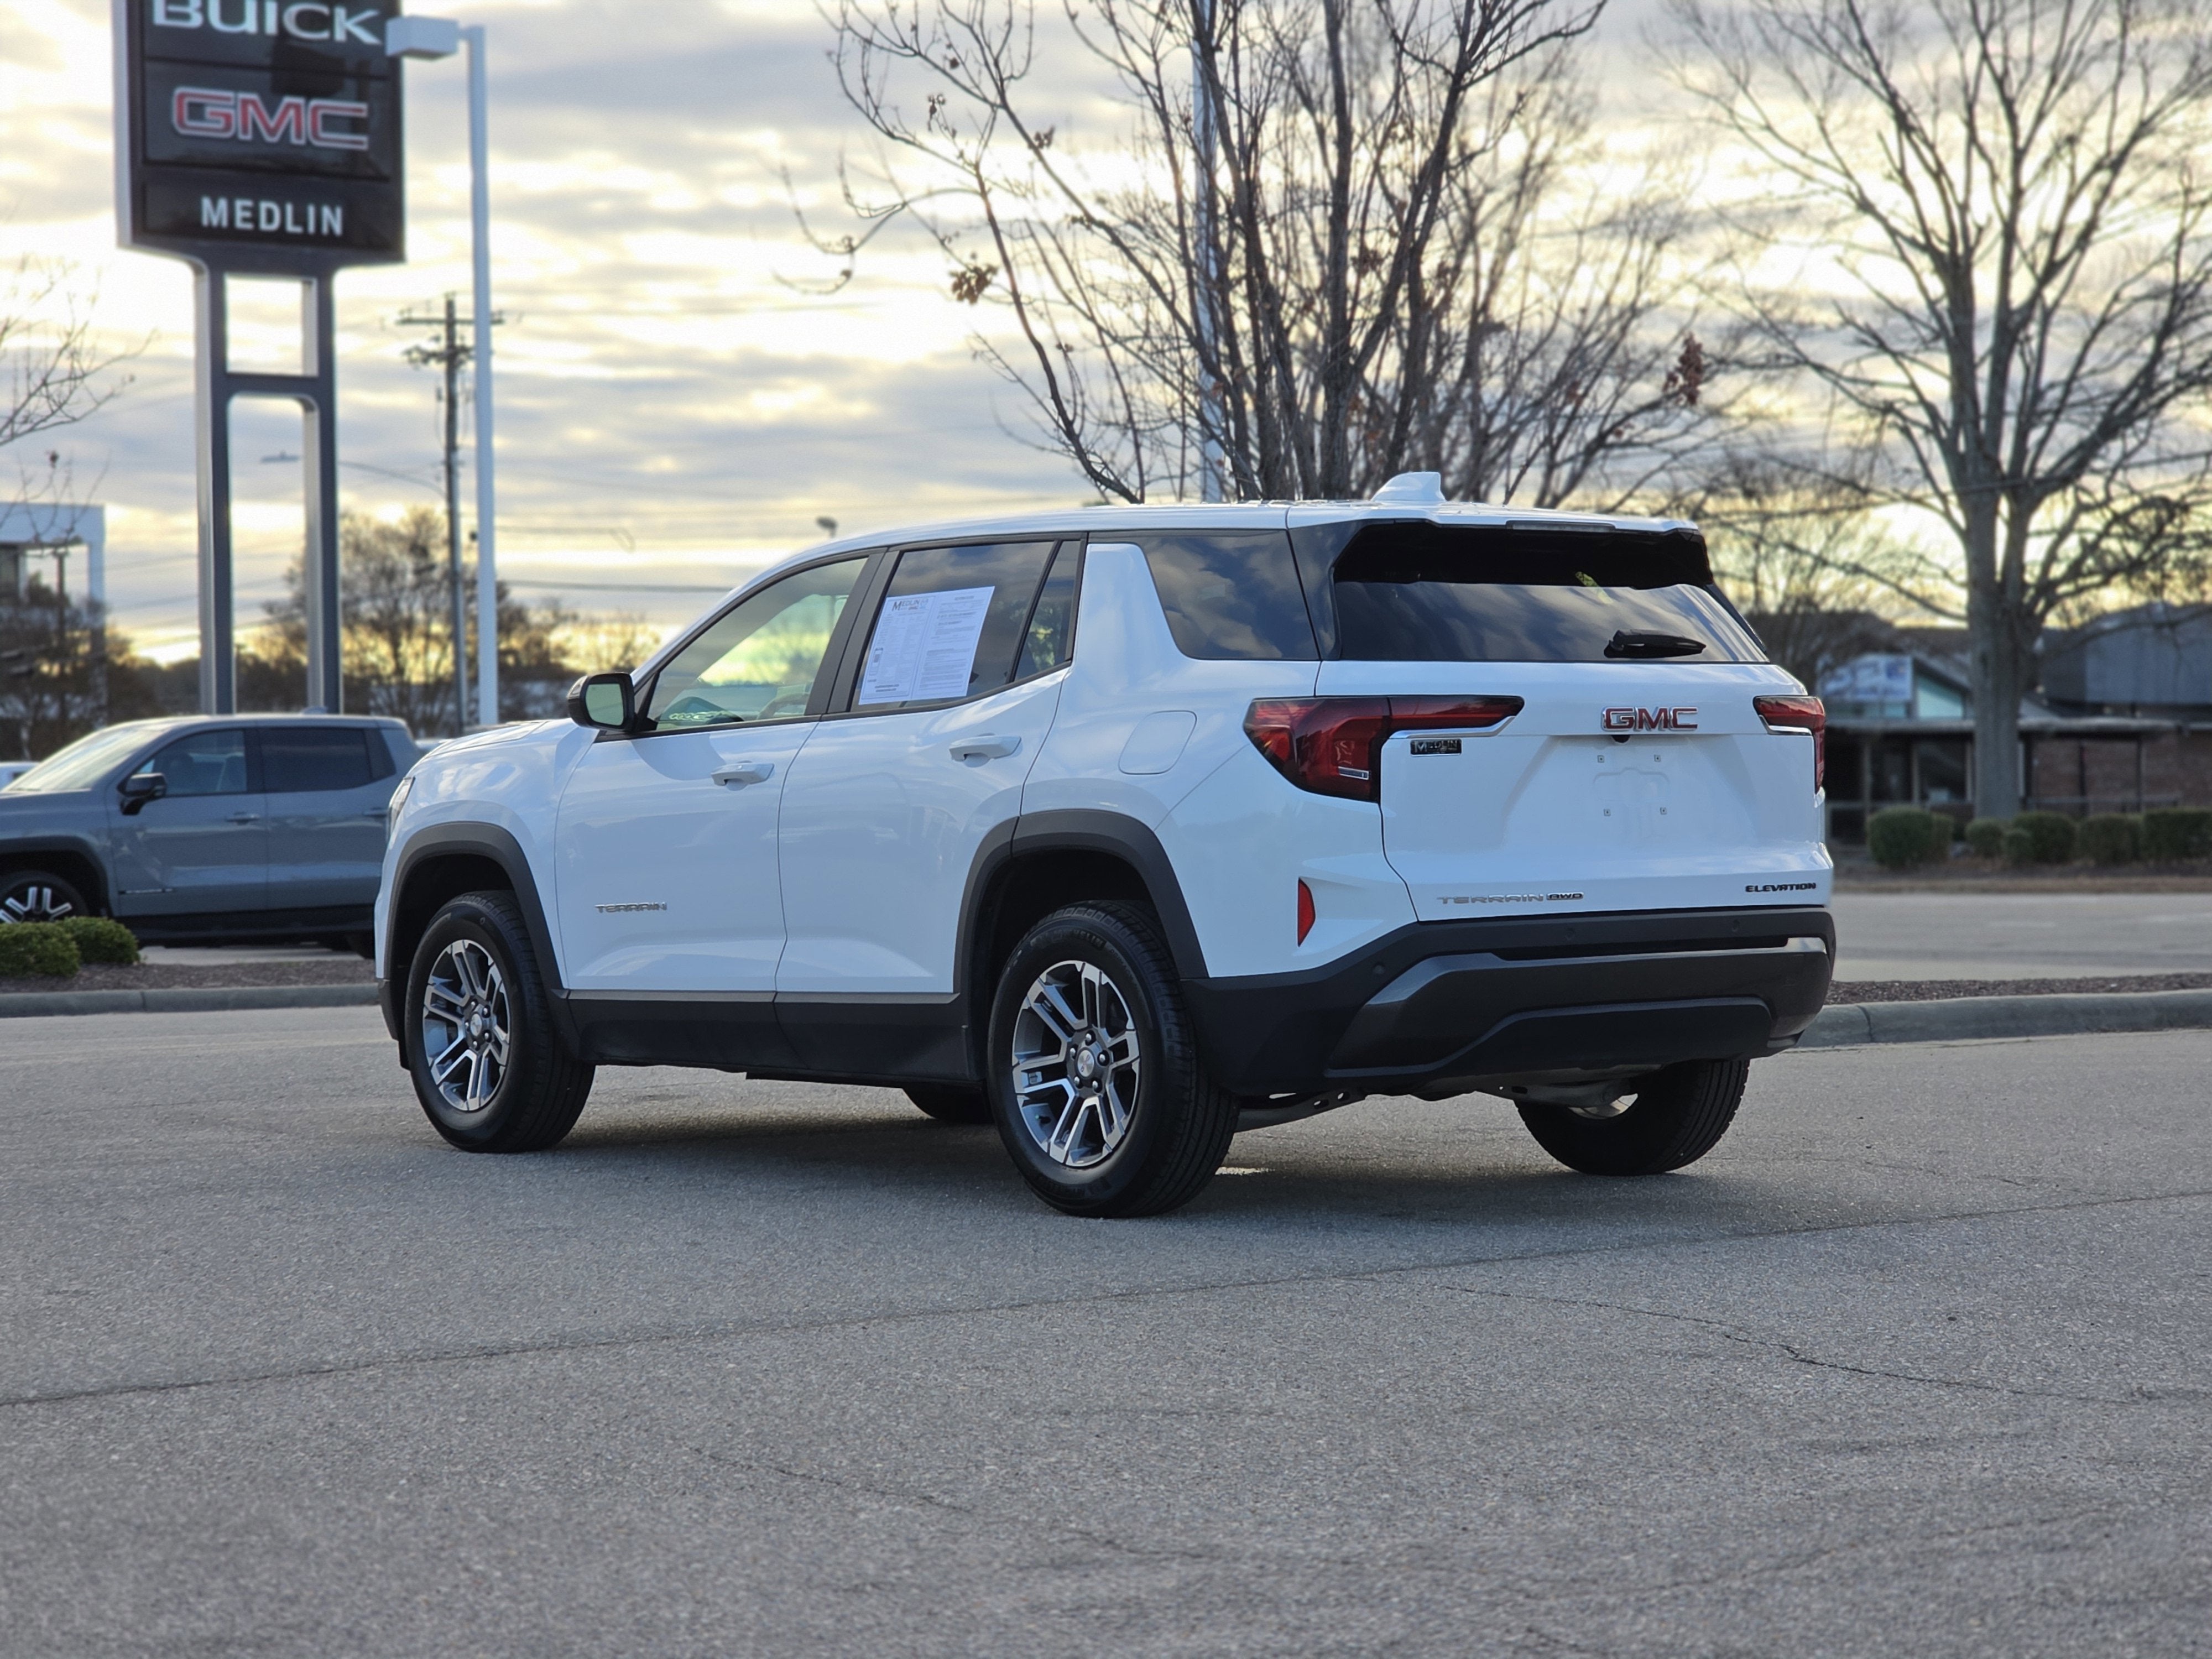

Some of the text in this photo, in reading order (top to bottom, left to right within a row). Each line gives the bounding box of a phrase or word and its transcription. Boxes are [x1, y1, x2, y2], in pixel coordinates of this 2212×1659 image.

[153, 0, 382, 45] BUICK
[173, 87, 368, 150] GMC
[201, 196, 343, 237] MEDLIN
[1601, 707, 1698, 731] GMC
[1437, 894, 1544, 904] TERRAIN
[1745, 883, 1817, 892] ELEVATION
[594, 902, 667, 913] TERRAIN
